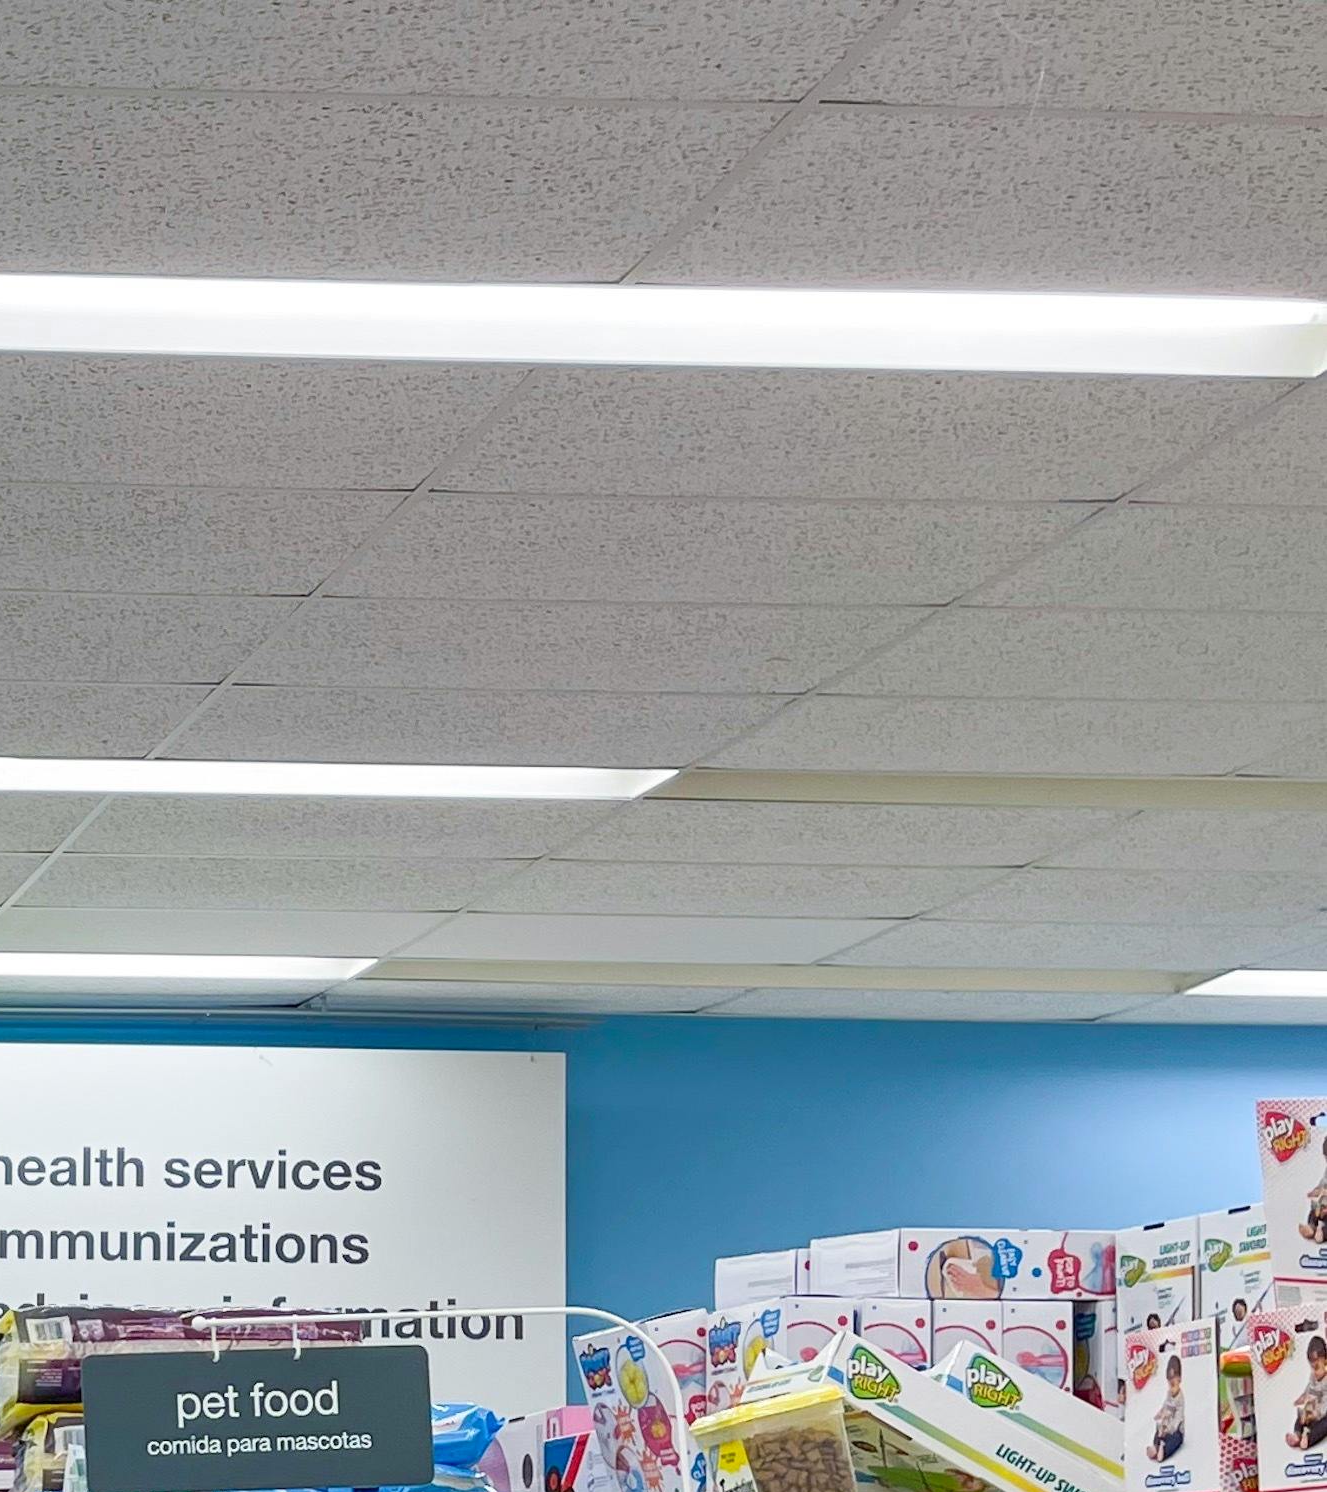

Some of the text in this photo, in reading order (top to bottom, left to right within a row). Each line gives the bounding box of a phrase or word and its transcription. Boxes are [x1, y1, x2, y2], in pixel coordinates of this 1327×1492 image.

[1266, 1113, 1294, 1146] play
[163, 1150, 383, 1192] services
[847, 1355, 885, 1384] play
[966, 1363, 1005, 1394] play
[853, 1374, 901, 1402] RIGHT
[973, 1383, 1022, 1411] RIGHT
[176, 1382, 339, 1428] pet food
[147, 1431, 372, 1457] comida para mascotas
[996, 1442, 1057, 1487] LIGHT-UP
